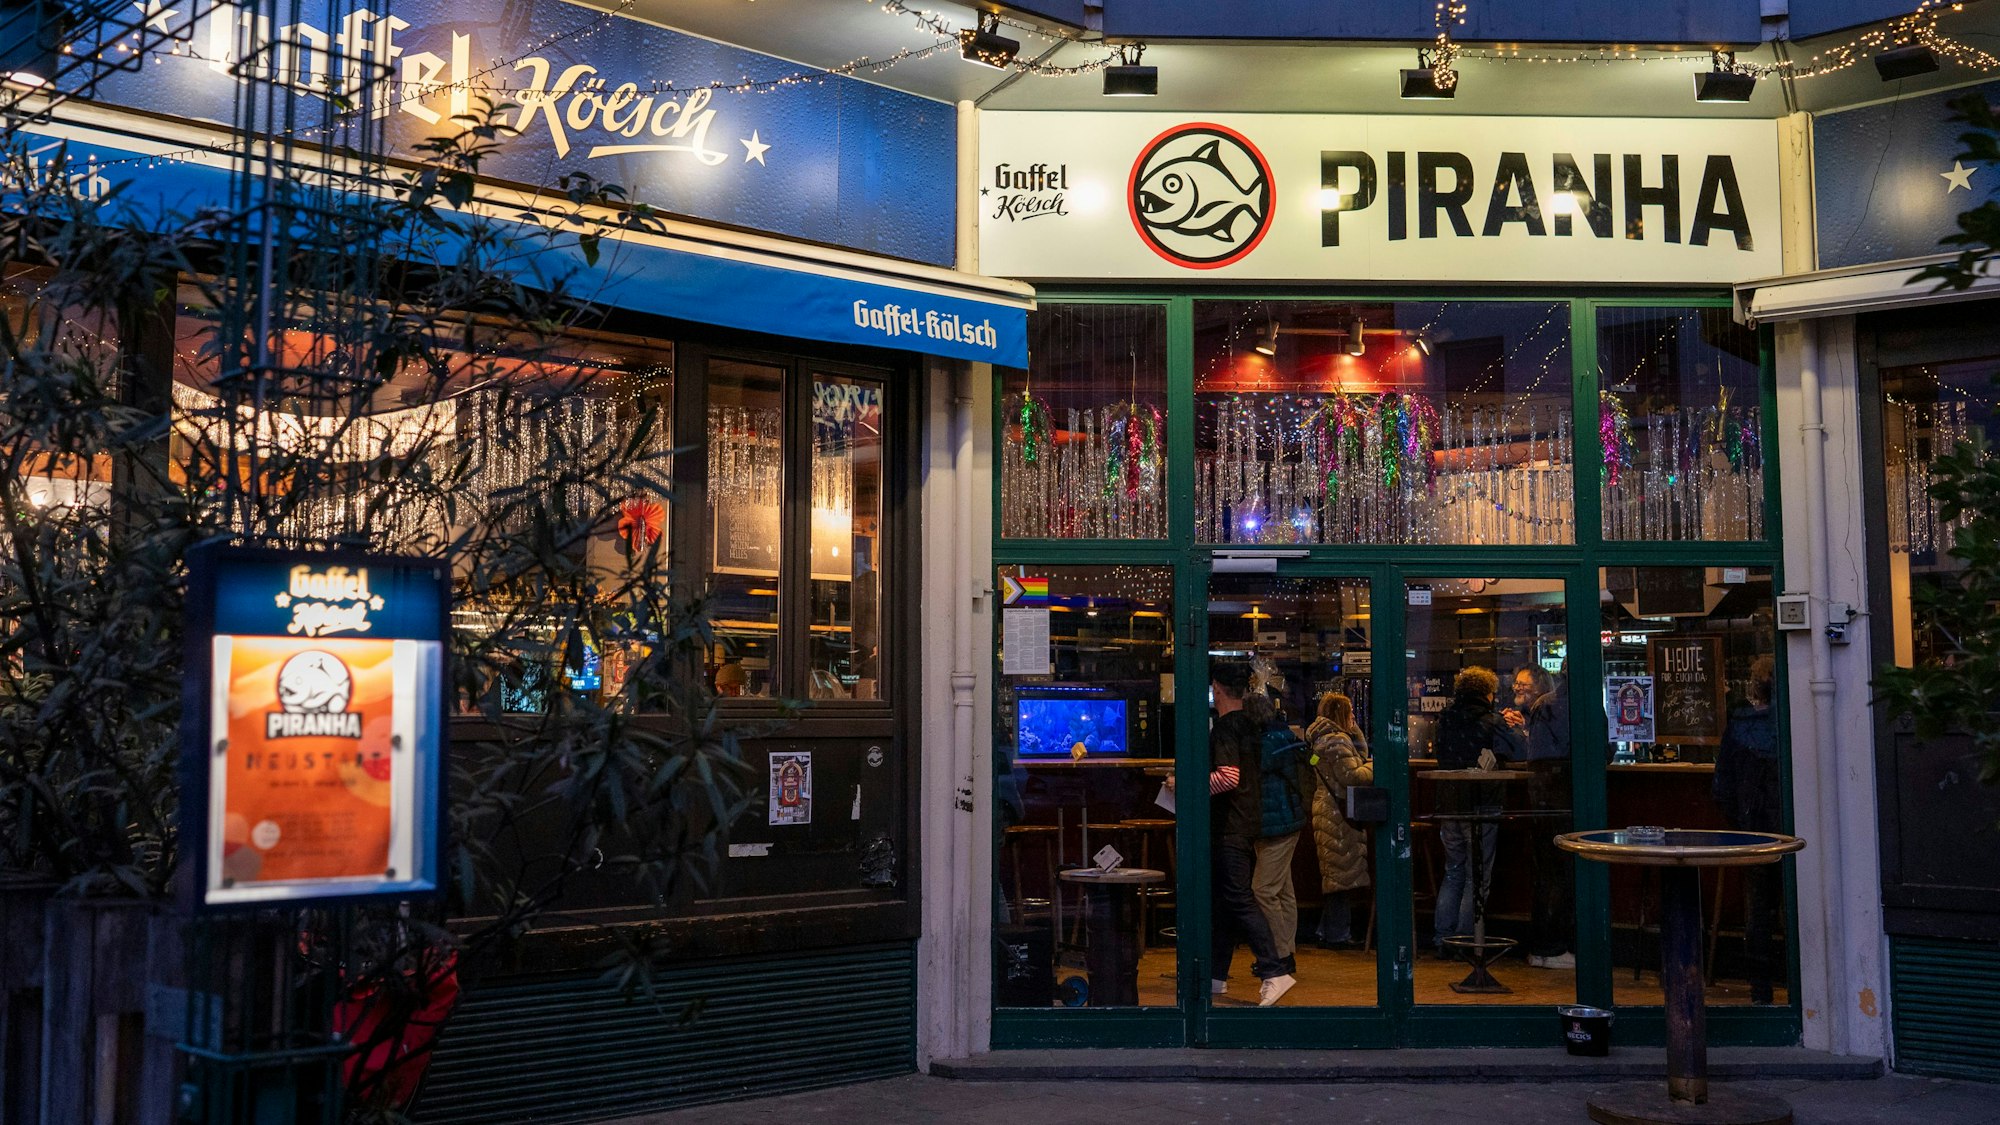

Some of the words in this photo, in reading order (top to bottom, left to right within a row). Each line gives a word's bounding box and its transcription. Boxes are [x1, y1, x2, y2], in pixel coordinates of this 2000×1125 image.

[500, 57, 728, 167] Kölsch
[995, 163, 1069, 192] Gaffel
[992, 193, 1069, 223] Kölsch
[1321, 151, 1755, 252] PIRANHA
[853, 299, 997, 350] Gaffel-Kölsch
[1664, 646, 1703, 671] HEUTE
[268, 714, 361, 738] PIRANHA
